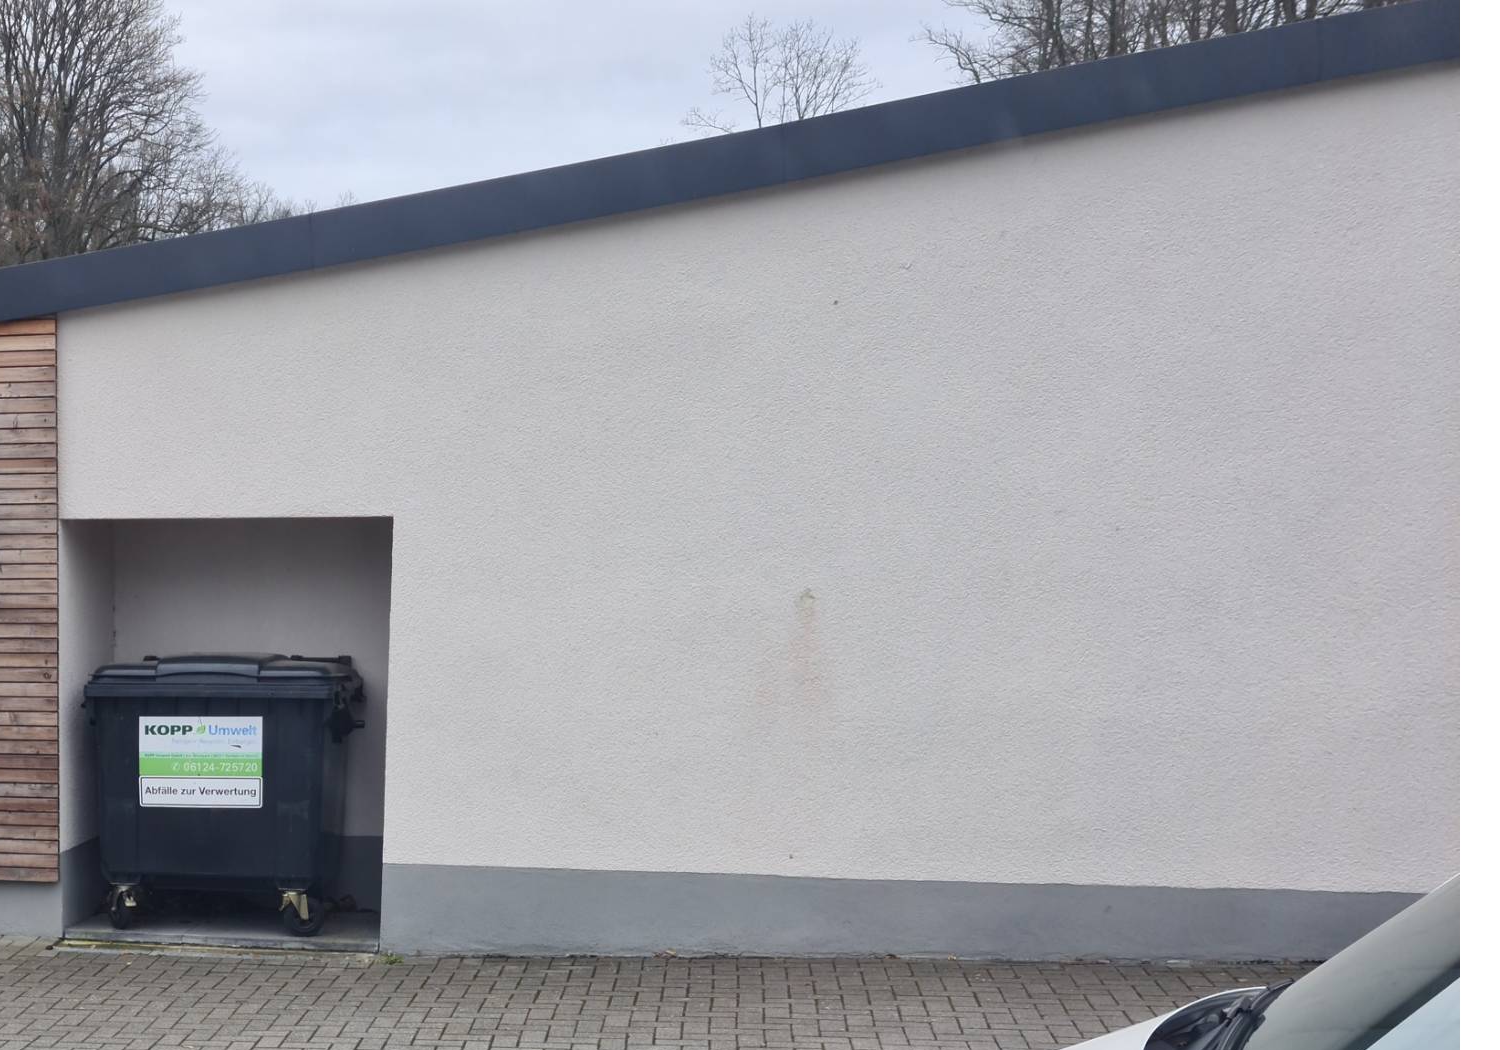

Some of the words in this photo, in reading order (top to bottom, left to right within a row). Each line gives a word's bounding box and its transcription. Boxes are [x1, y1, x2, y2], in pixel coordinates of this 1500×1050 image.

[144, 724, 193, 736] KOPP
[208, 724, 257, 736] Umwelt
[183, 762, 258, 772] 06124-725720
[145, 786, 178, 795] Abfälle
[198, 786, 257, 798] Verwertung
